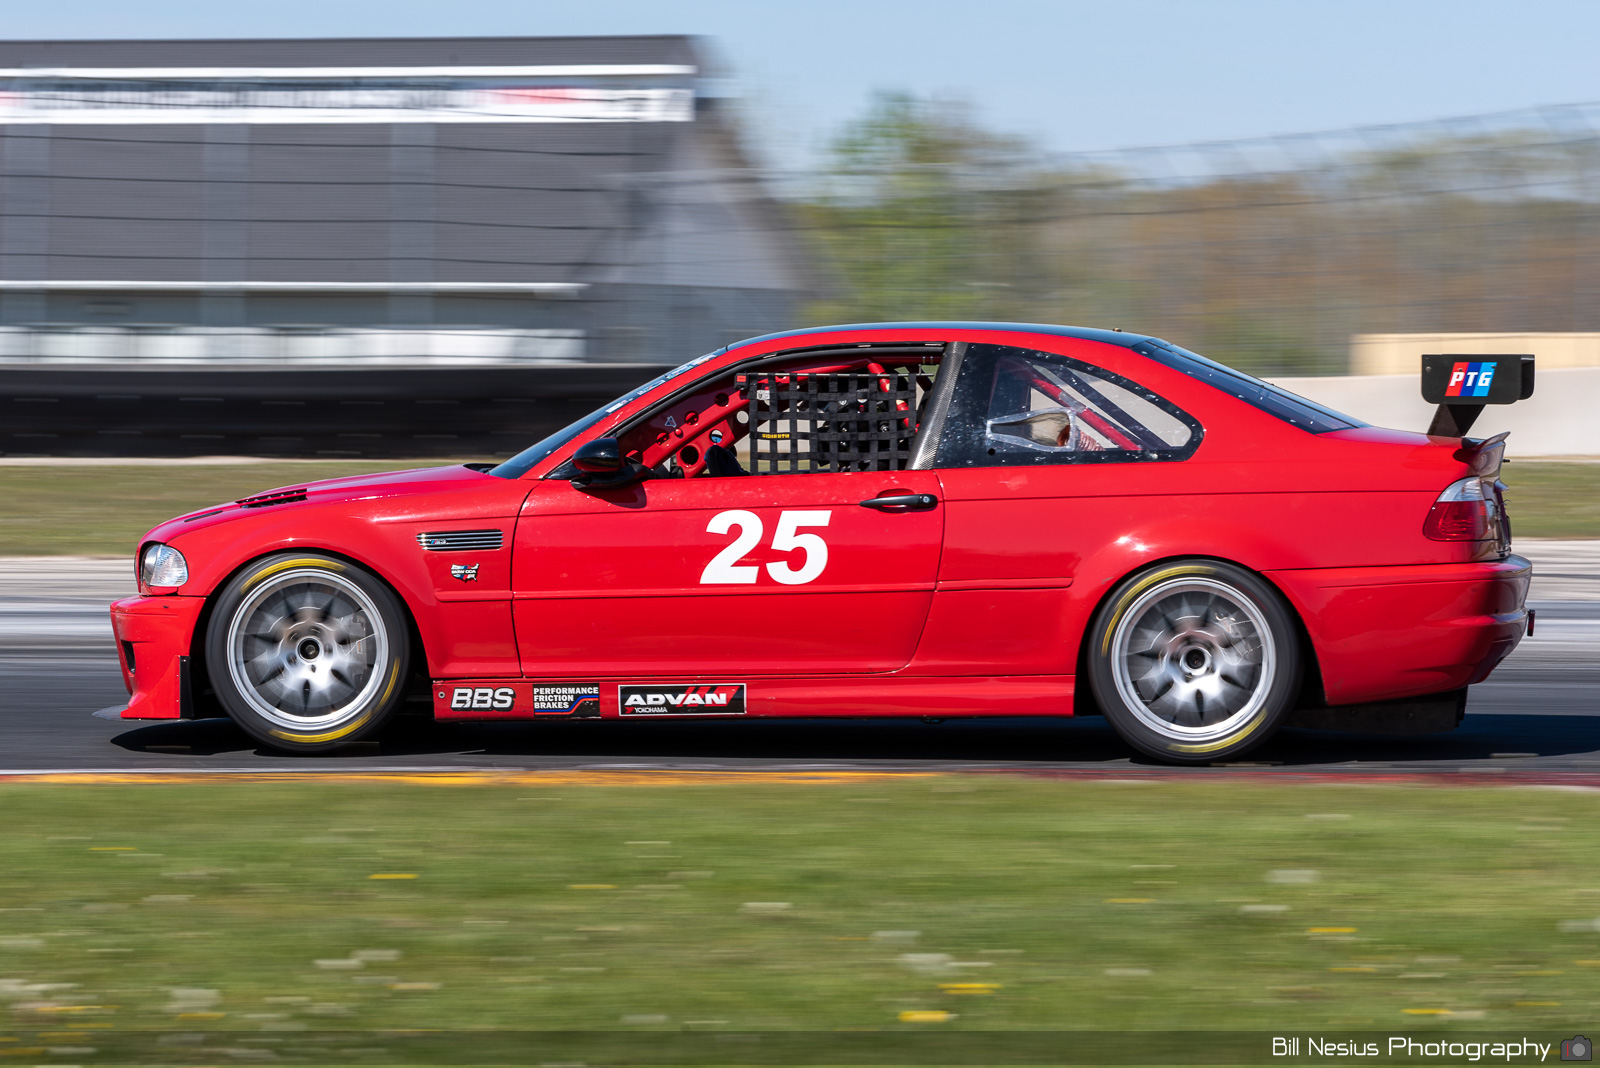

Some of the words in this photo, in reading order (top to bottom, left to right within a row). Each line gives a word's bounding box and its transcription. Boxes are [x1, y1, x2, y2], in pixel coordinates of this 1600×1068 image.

[1449, 371, 1493, 386] PTG
[699, 509, 832, 585] 25
[451, 687, 515, 710] BBS
[533, 687, 599, 695] PERFORMANCE
[624, 693, 727, 706] ADVAN
